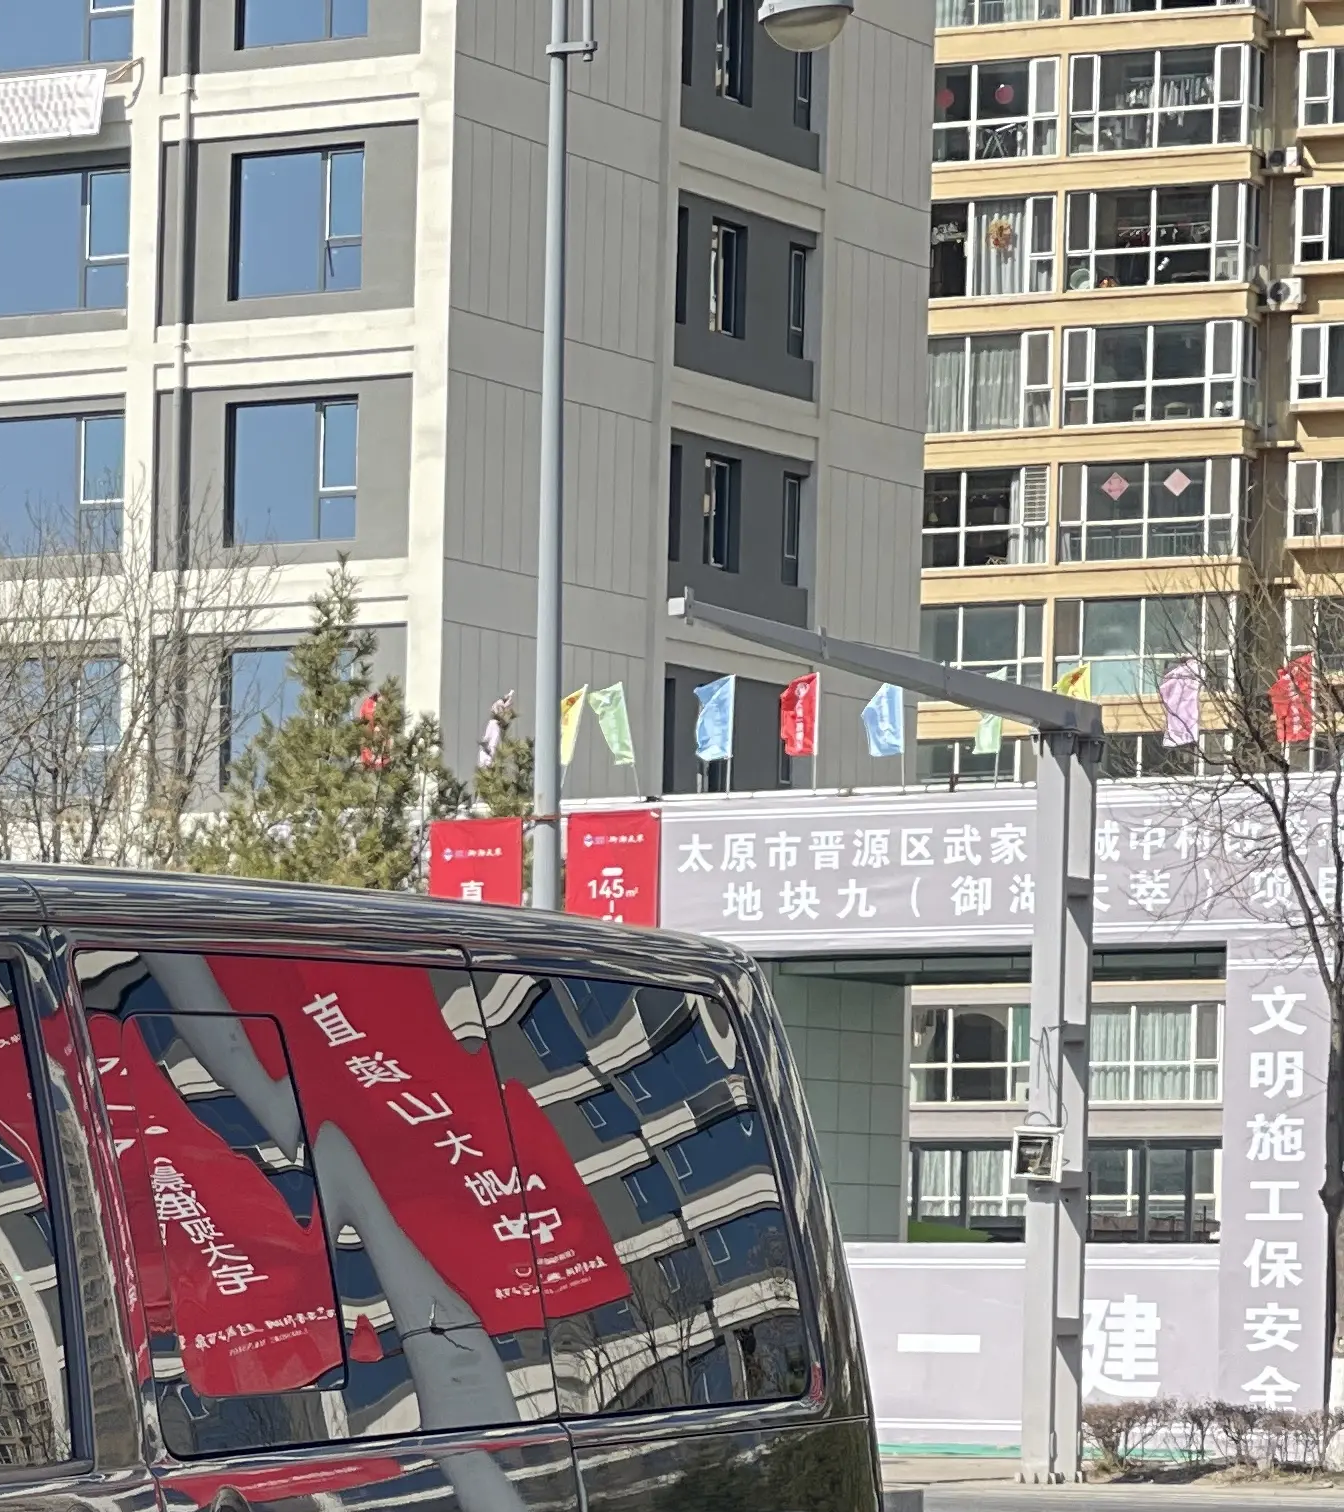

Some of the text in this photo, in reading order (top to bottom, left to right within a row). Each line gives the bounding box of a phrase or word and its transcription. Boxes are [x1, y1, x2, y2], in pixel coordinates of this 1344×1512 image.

[1241, 985, 1308, 1411] 文明施工保安全
